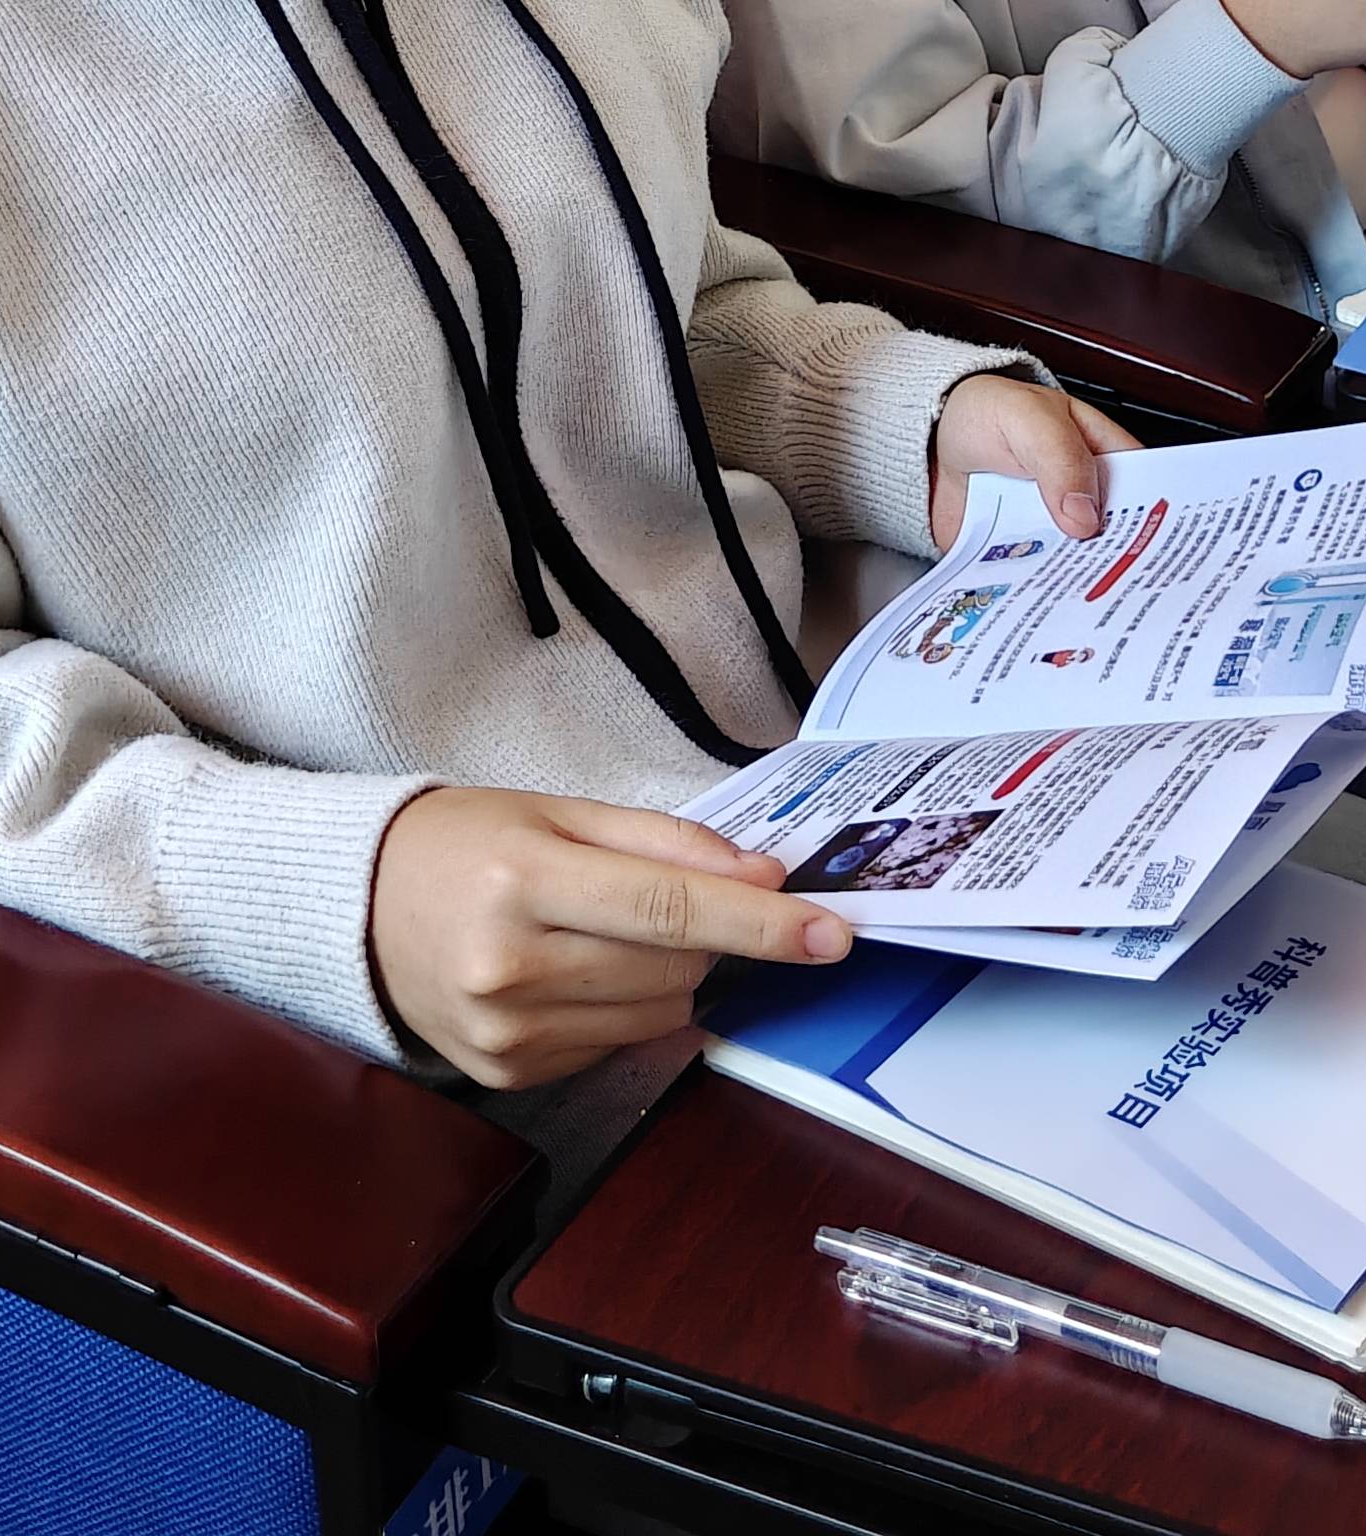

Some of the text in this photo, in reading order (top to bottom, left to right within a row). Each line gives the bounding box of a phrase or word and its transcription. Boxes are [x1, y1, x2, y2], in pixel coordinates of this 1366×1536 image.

[1107, 933, 1327, 1130] 科普秀实验项目
